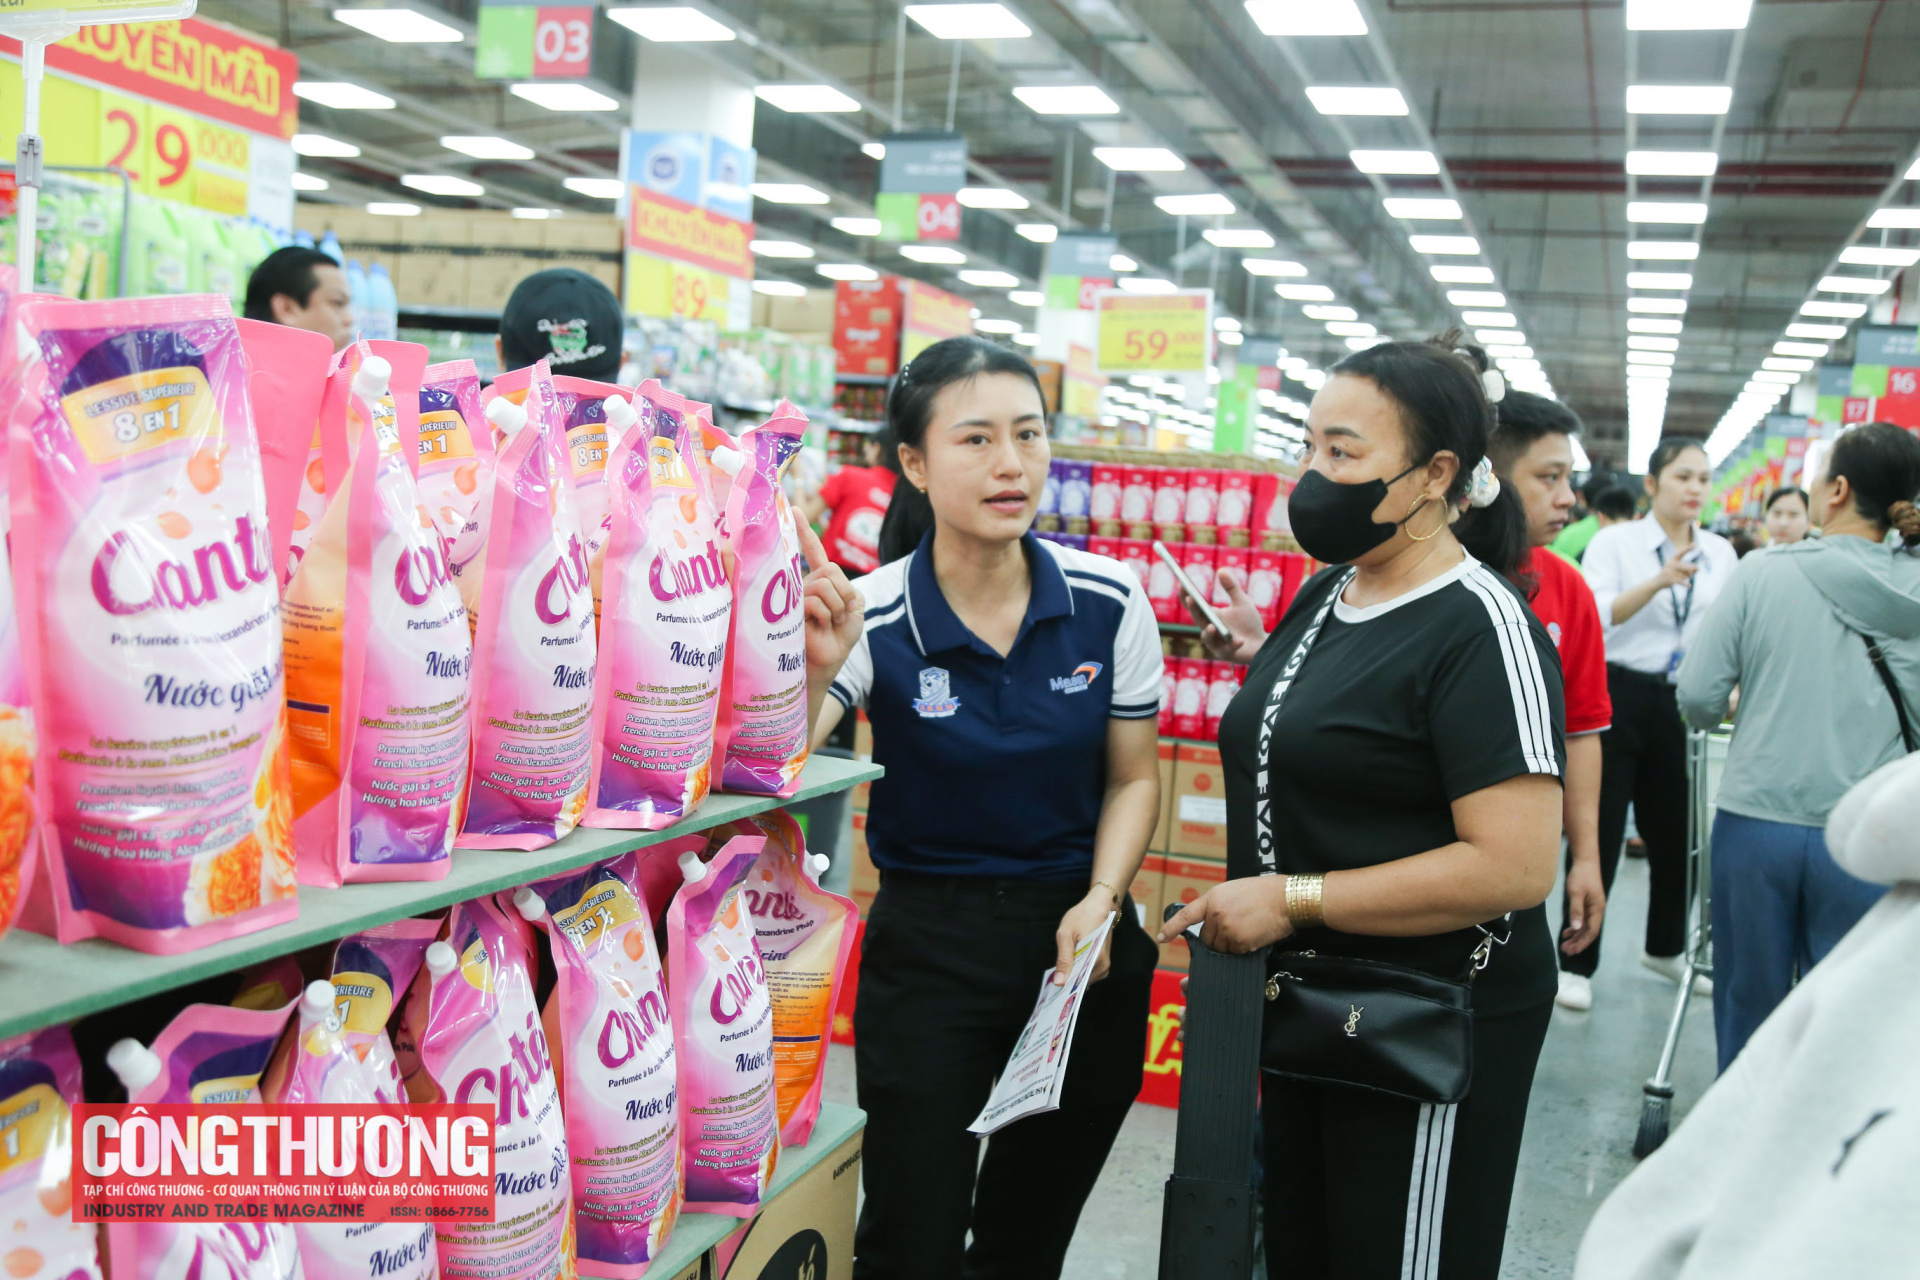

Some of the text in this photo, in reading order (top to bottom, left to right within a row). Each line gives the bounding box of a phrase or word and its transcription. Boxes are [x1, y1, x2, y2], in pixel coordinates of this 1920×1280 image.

[536, 21, 590, 62] 03
[106, 110, 191, 187] 29
[919, 201, 959, 231] 04
[1124, 328, 1169, 361] 59
[1891, 371, 1916, 394] 16
[85, 381, 197, 418] LESSIVE SUPÉRIEURE
[112, 402, 181, 443] 8 EN 1
[418, 420, 457, 434] UPÉRIEURE
[425, 650, 462, 678] Nước
[669, 640, 706, 668] Nước
[144, 673, 224, 706] Nước
[552, 664, 587, 688] Nước
[582, 919, 598, 937] EN
[755, 924, 795, 937] lexandrine
[735, 1052, 766, 1073] Nước
[625, 1097, 664, 1121] Nước
[495, 1171, 546, 1196] Nước
[368, 1243, 417, 1278] Nước
